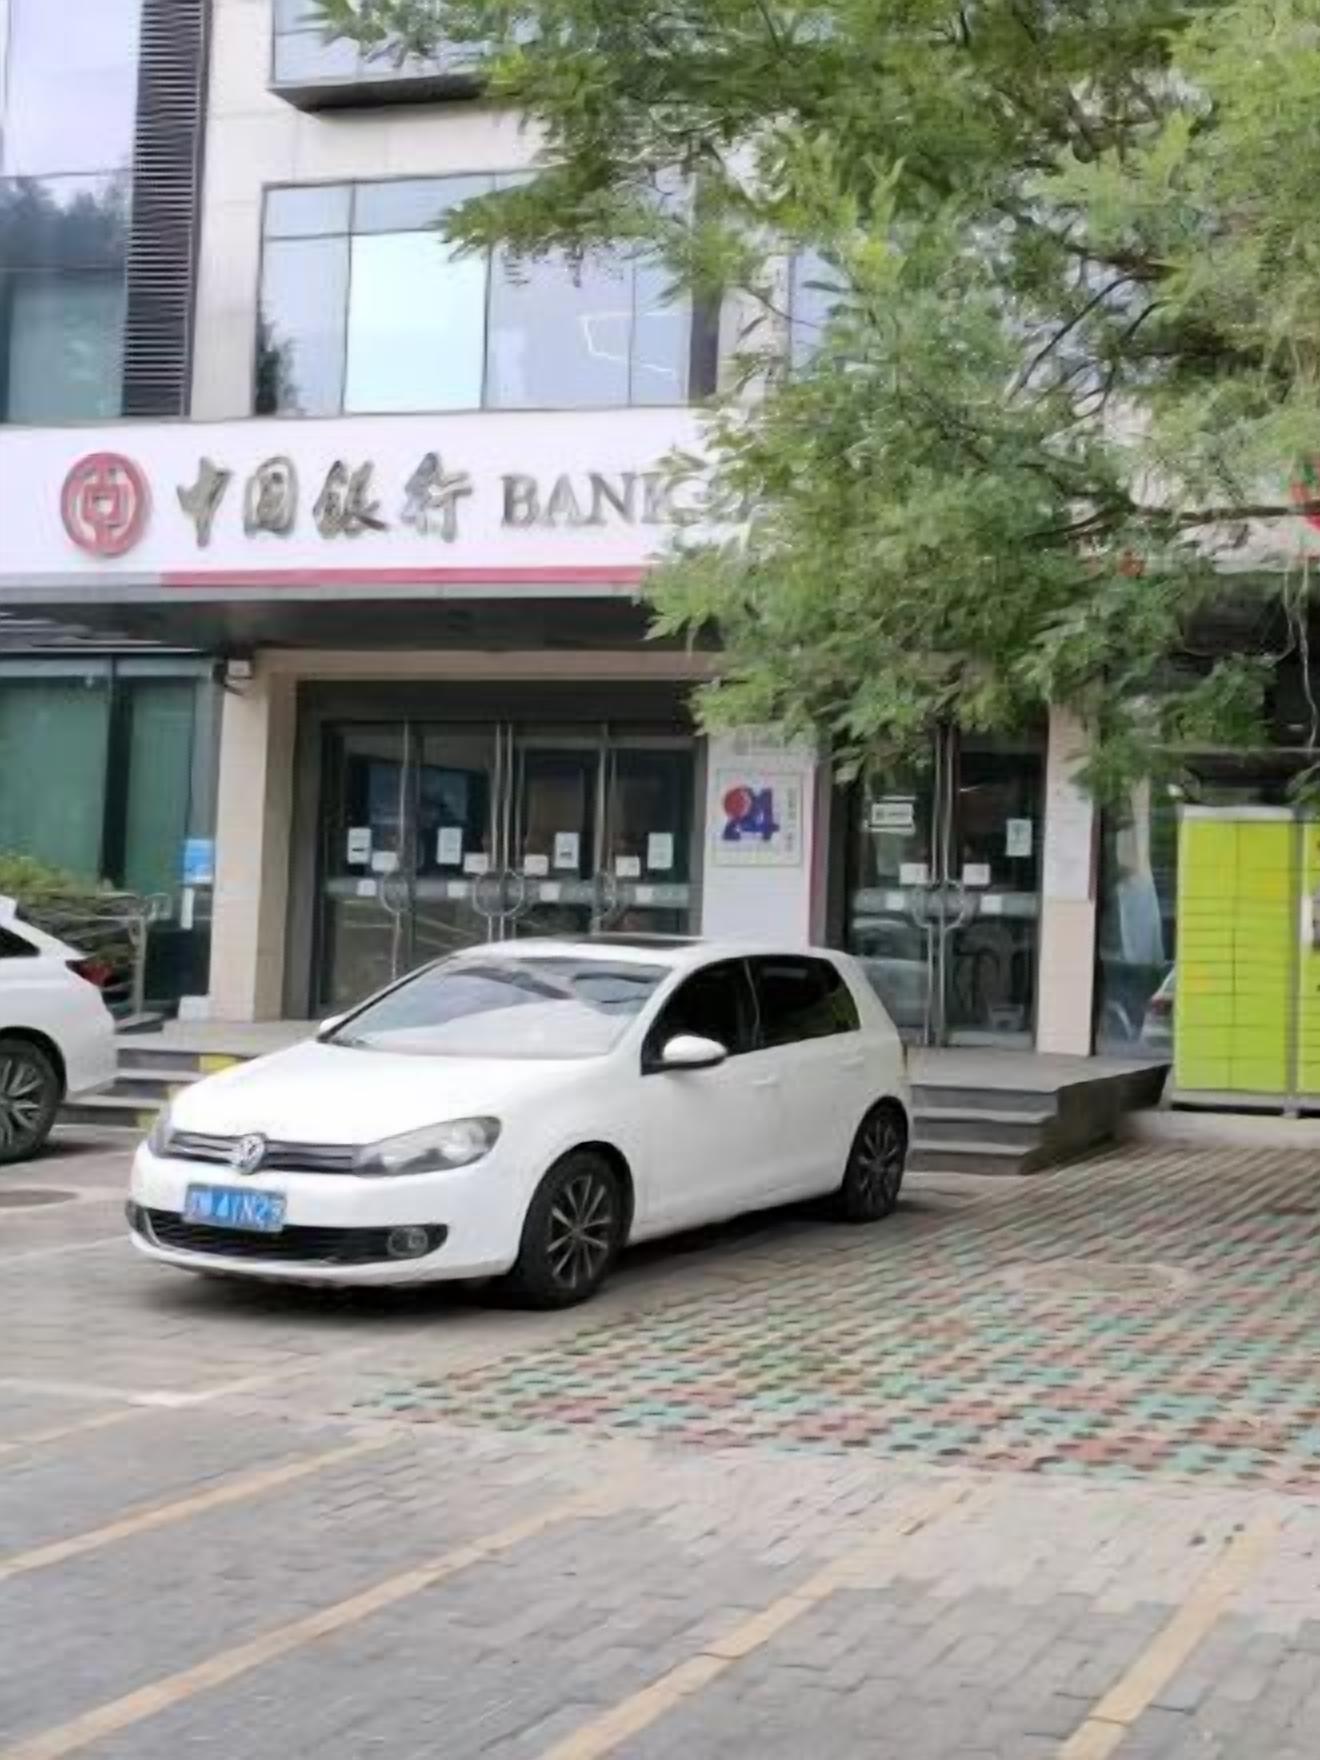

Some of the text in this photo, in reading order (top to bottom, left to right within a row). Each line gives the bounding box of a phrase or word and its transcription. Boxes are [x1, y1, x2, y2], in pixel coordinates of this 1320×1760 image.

[176, 452, 473, 547] 中国银行
[722, 785, 780, 841] 24
